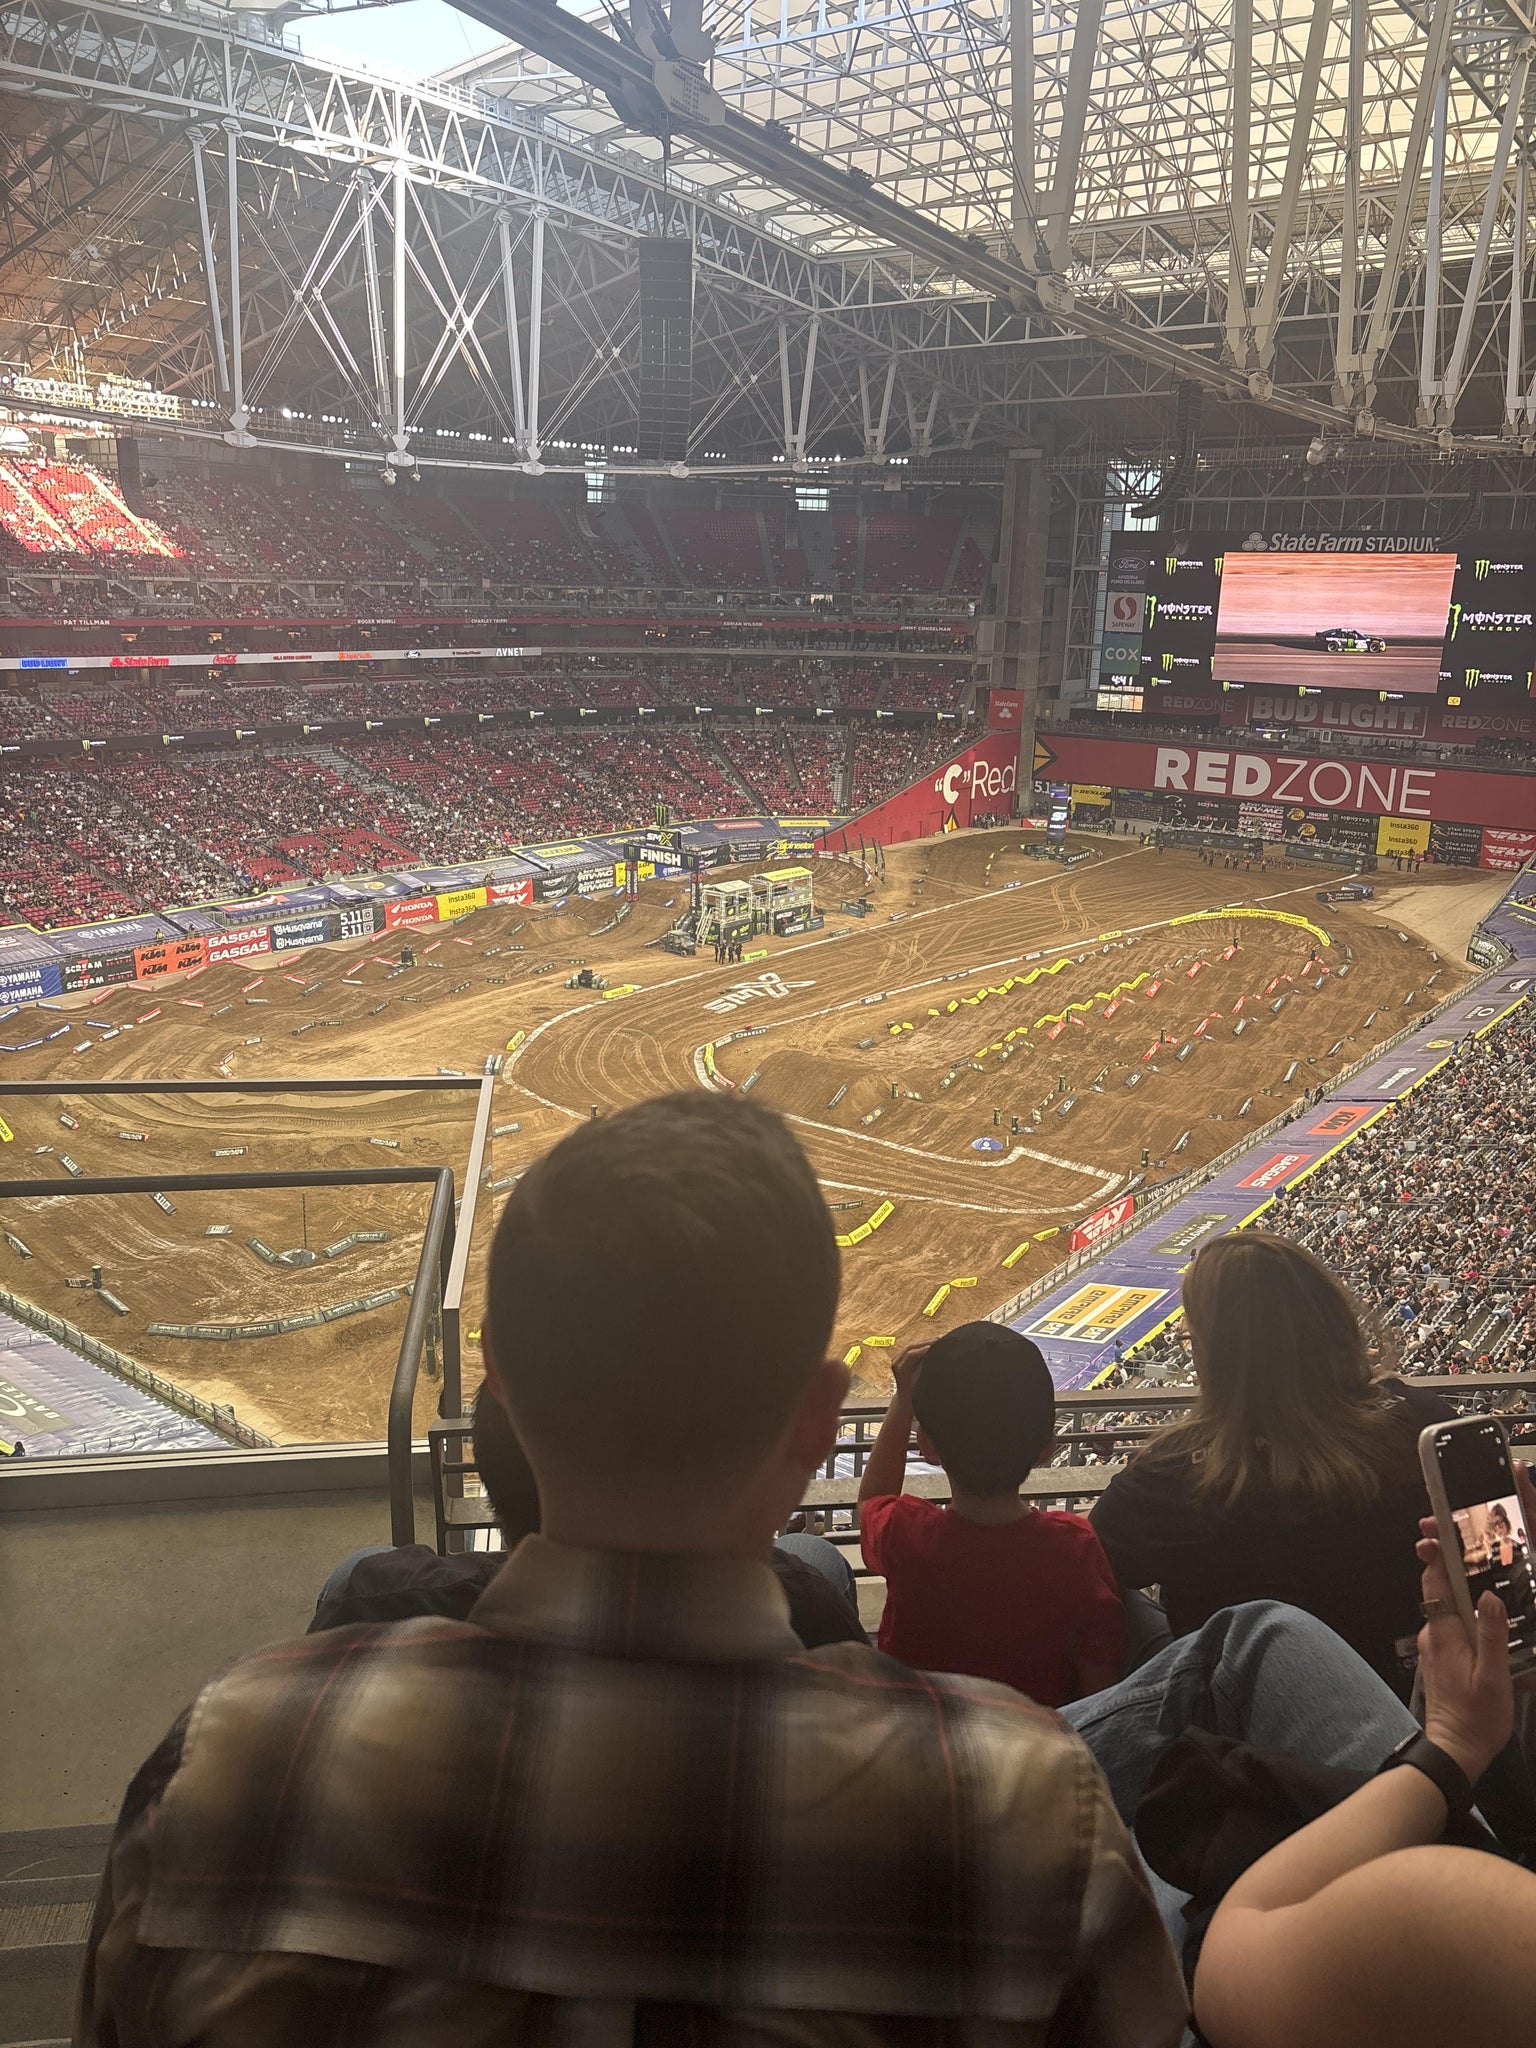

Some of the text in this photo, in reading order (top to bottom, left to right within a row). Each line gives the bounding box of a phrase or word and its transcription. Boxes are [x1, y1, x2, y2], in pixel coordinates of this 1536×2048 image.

[1157, 603, 1213, 615] MONSTER
[1462, 612, 1533, 626] MONSTER
[1105, 647, 1139, 660] COX
[1252, 696, 1421, 730] BUD LIGHT
[971, 755, 1017, 800] Red
[1390, 821, 1420, 831] Insta360
[1388, 835, 1418, 845] Insta360
[640, 848, 681, 867] FINISH
[448, 892, 476, 903] Insta360
[401, 901, 434, 912] HONDA
[449, 904, 476, 916] Insta360
[340, 909, 362, 925] 5.11
[402, 914, 434, 925] HONDA
[93, 921, 143, 938] YAMAHA
[282, 919, 323, 934] Husqvarna
[341, 923, 363, 939] 5.11
[208, 927, 267, 948] GASGAS
[285, 934, 324, 947] Husqvarna
[175, 942, 201, 954] KTM
[209, 941, 269, 962] GASGAS
[140, 949, 166, 961] KTM
[141, 963, 168, 976] KTM
[177, 957, 203, 969] KTM
[8, 969, 41, 983] YAMAHA
[9, 985, 43, 999] YAMAHA
[1250, 1154, 1300, 1188] GASGAS
